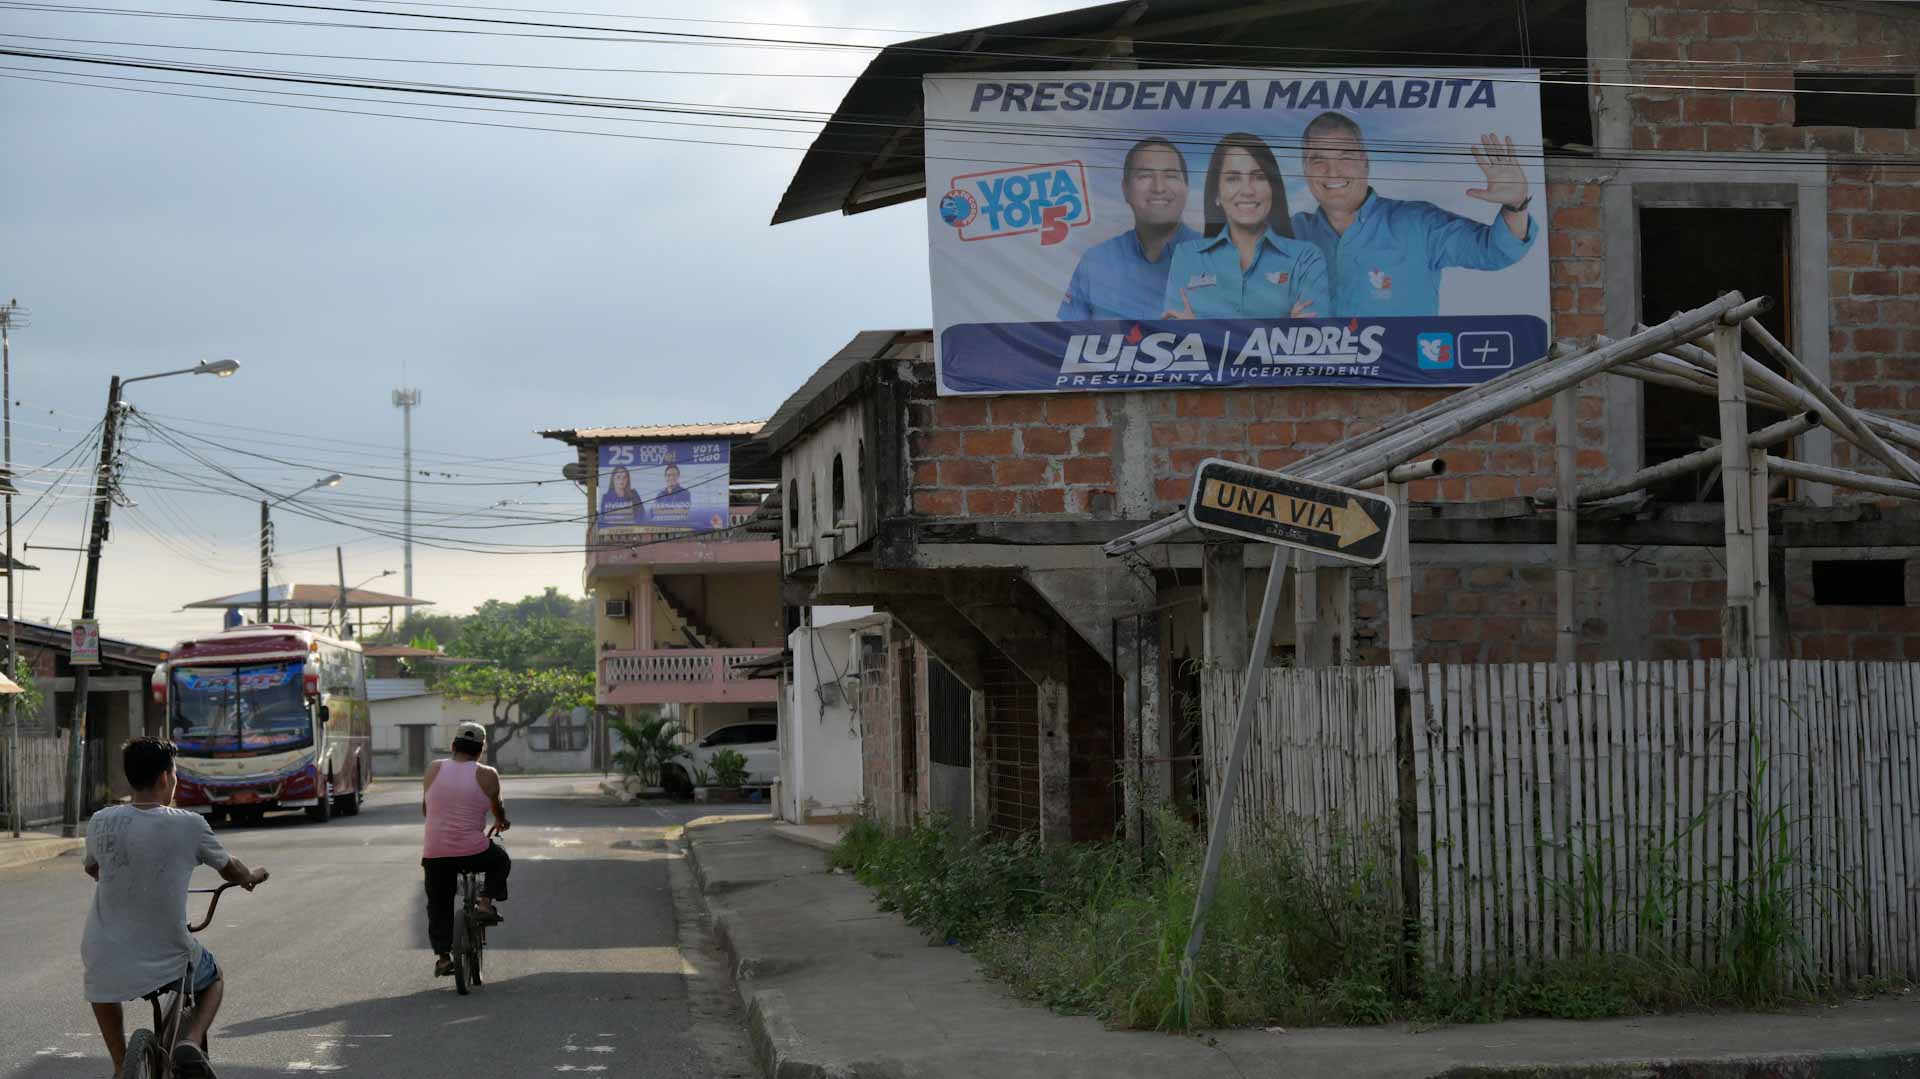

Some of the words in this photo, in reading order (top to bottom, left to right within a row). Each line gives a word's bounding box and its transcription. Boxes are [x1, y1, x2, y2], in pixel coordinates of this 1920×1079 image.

[971, 79, 1251, 112] PRESIDENTA
[1264, 79, 1496, 110] MANABITA
[976, 169, 1079, 203] VOTA
[1056, 372, 1214, 386] PRESIDENTA
[1230, 365, 1380, 377] VICEPRESIDENTE
[608, 445, 635, 465] 25
[692, 444, 720, 454] VOTA
[693, 453, 720, 463] TODO
[1217, 483, 1276, 520] UNA
[1290, 499, 1334, 532] VIA
